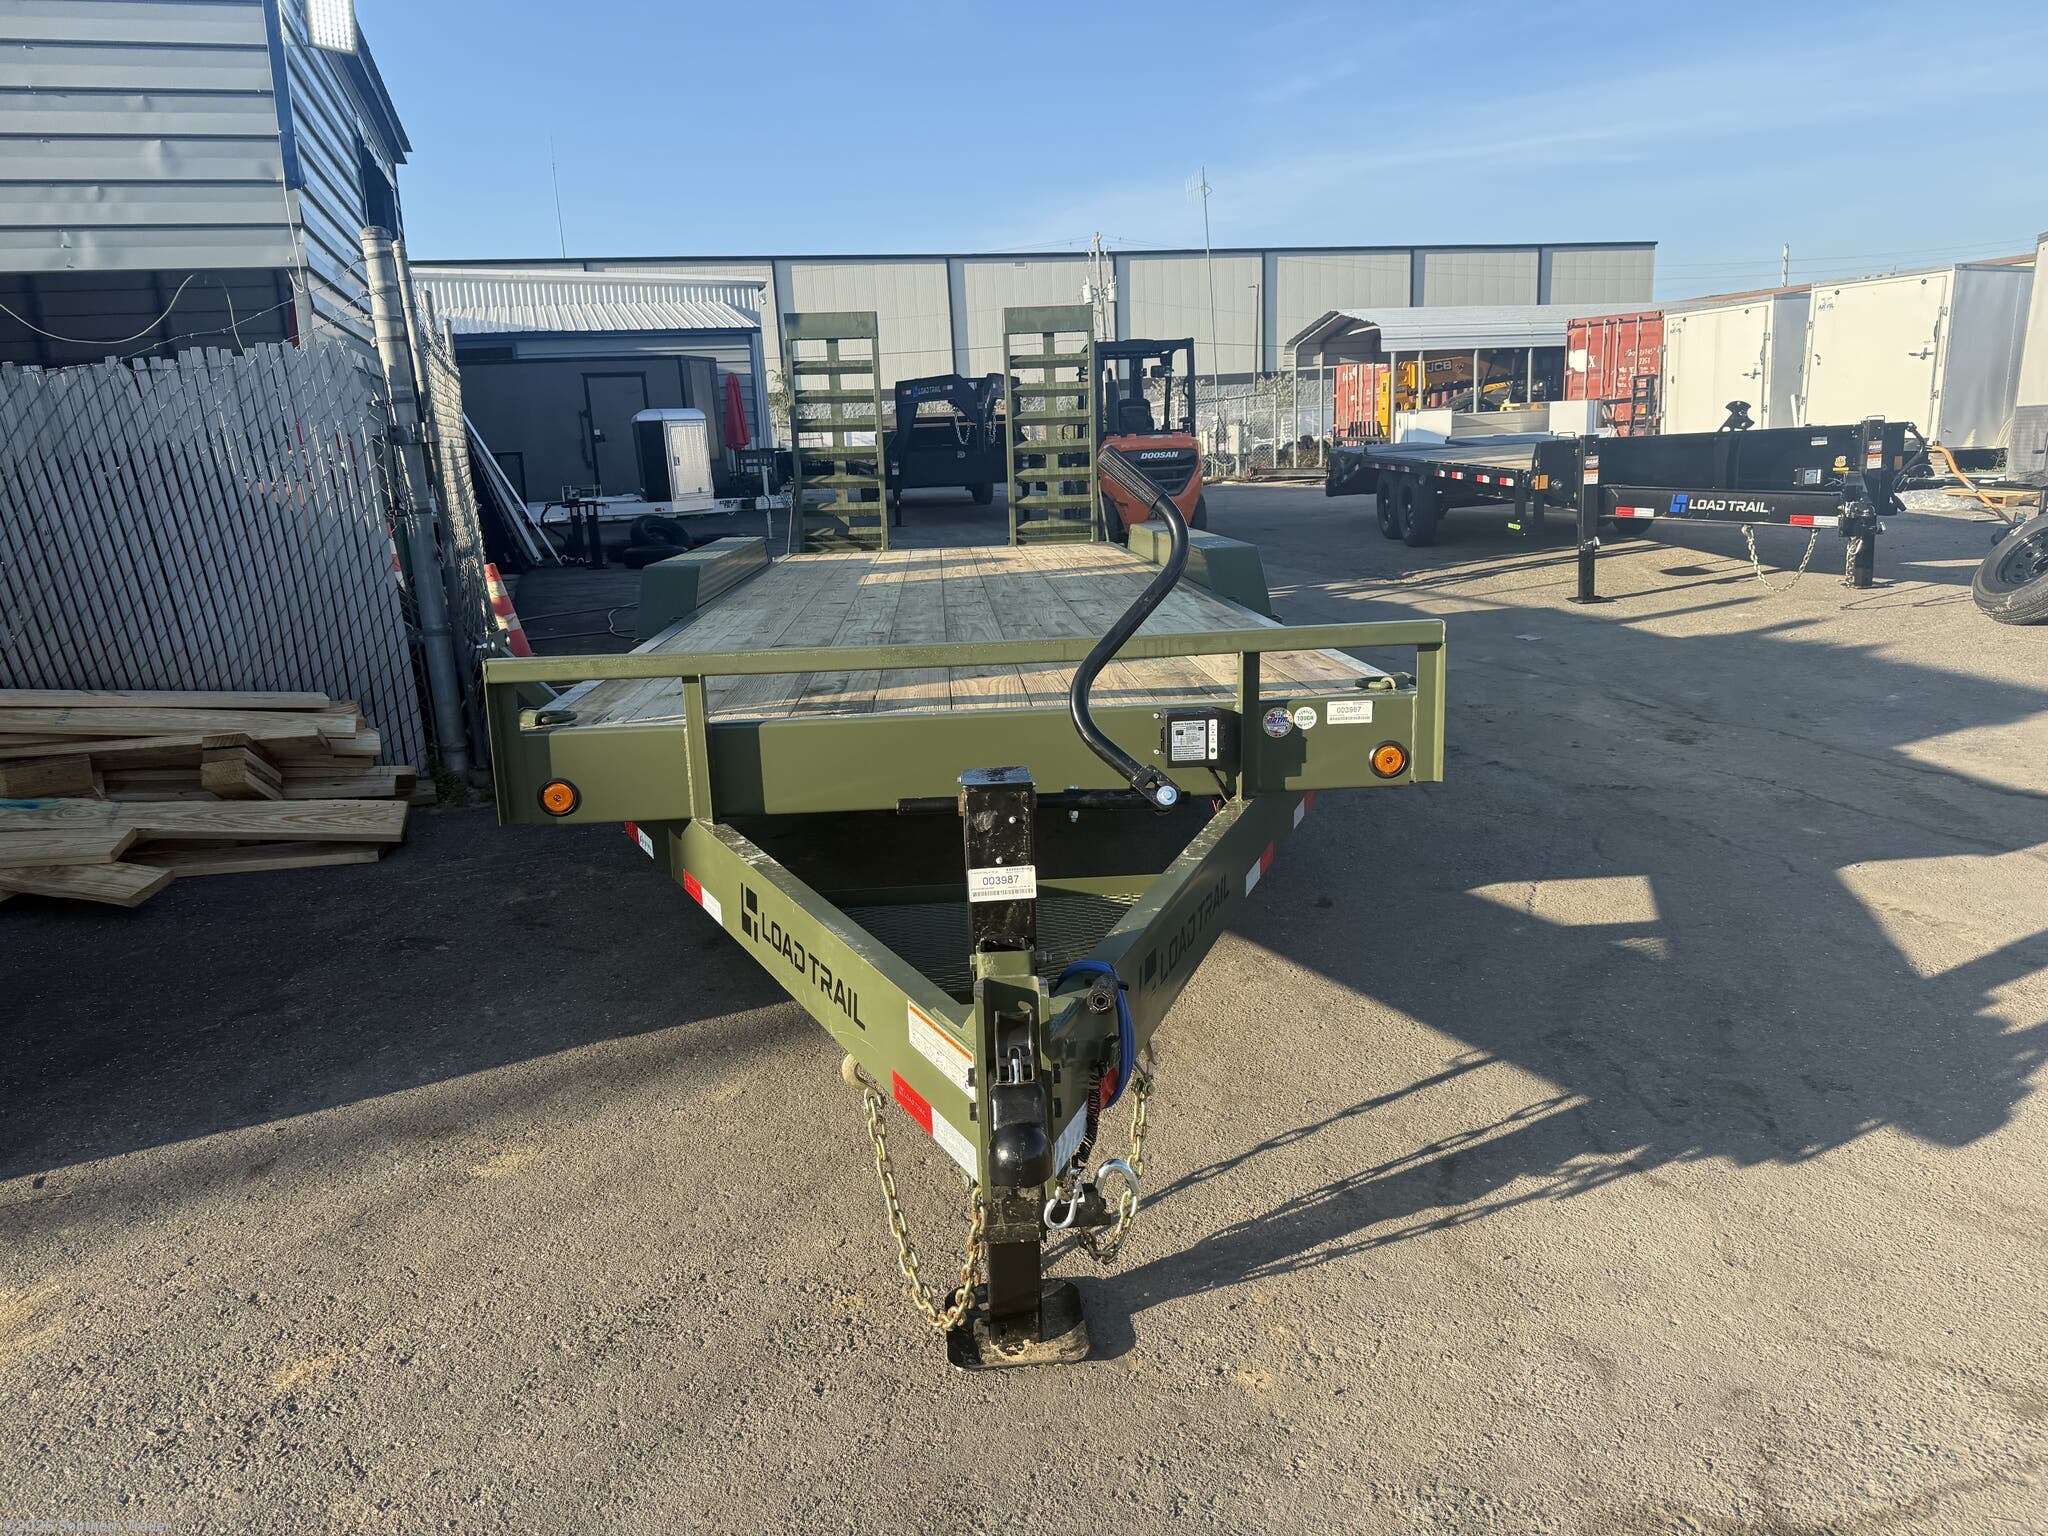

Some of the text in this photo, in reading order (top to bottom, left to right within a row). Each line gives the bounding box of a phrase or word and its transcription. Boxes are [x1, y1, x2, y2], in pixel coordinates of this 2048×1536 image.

[1427, 360, 1452, 373] JCB
[1140, 451, 1179, 460] DOOSAN
[1688, 498, 1769, 513] LOAD TRAIL
[1336, 706, 1362, 714] 003987
[982, 874, 1019, 886] 003987
[1160, 874, 1230, 985] LOAD TRAIL
[761, 911, 866, 1031] LOAD TRAIL
